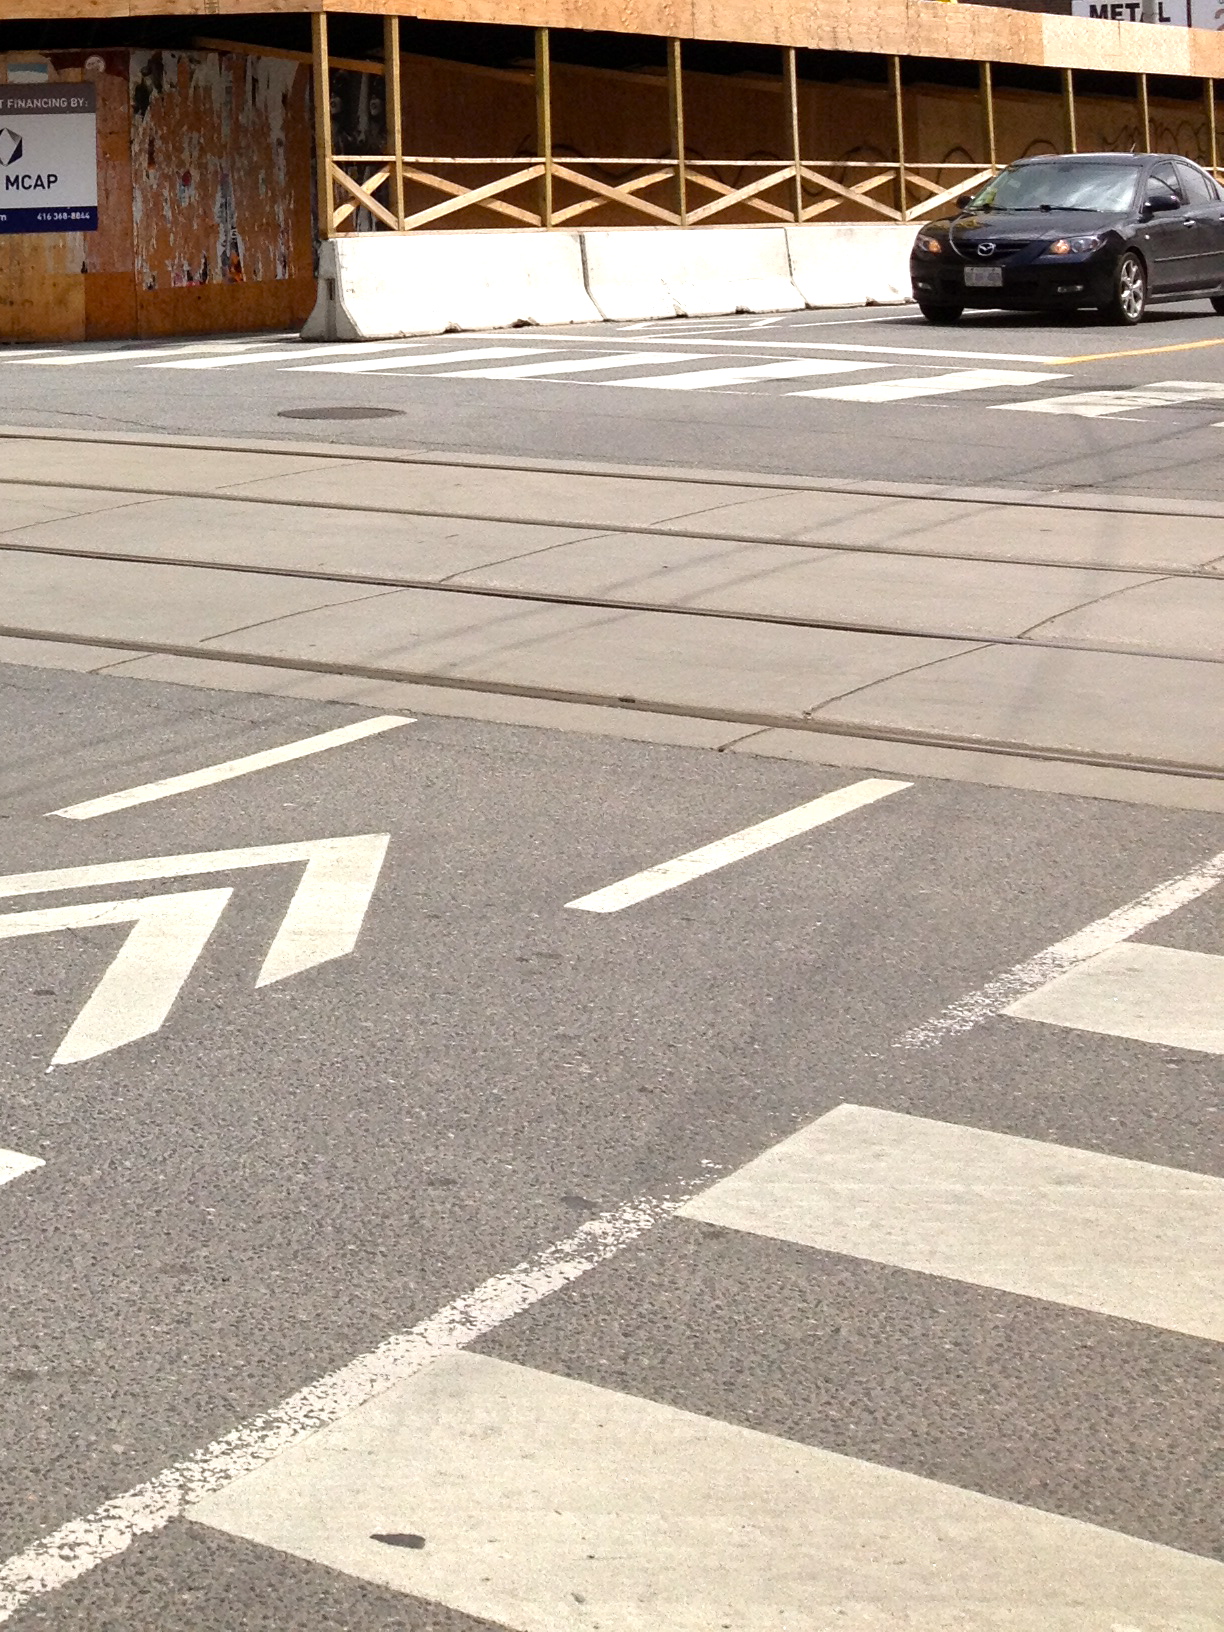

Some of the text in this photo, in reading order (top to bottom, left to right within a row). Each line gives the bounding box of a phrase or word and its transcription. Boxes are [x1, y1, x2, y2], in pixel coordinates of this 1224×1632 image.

[1089, 1, 1172, 23] METL
[7, 97, 68, 109] FINANCING
[70, 97, 88, 108] BY:
[5, 173, 58, 191] MCAP
